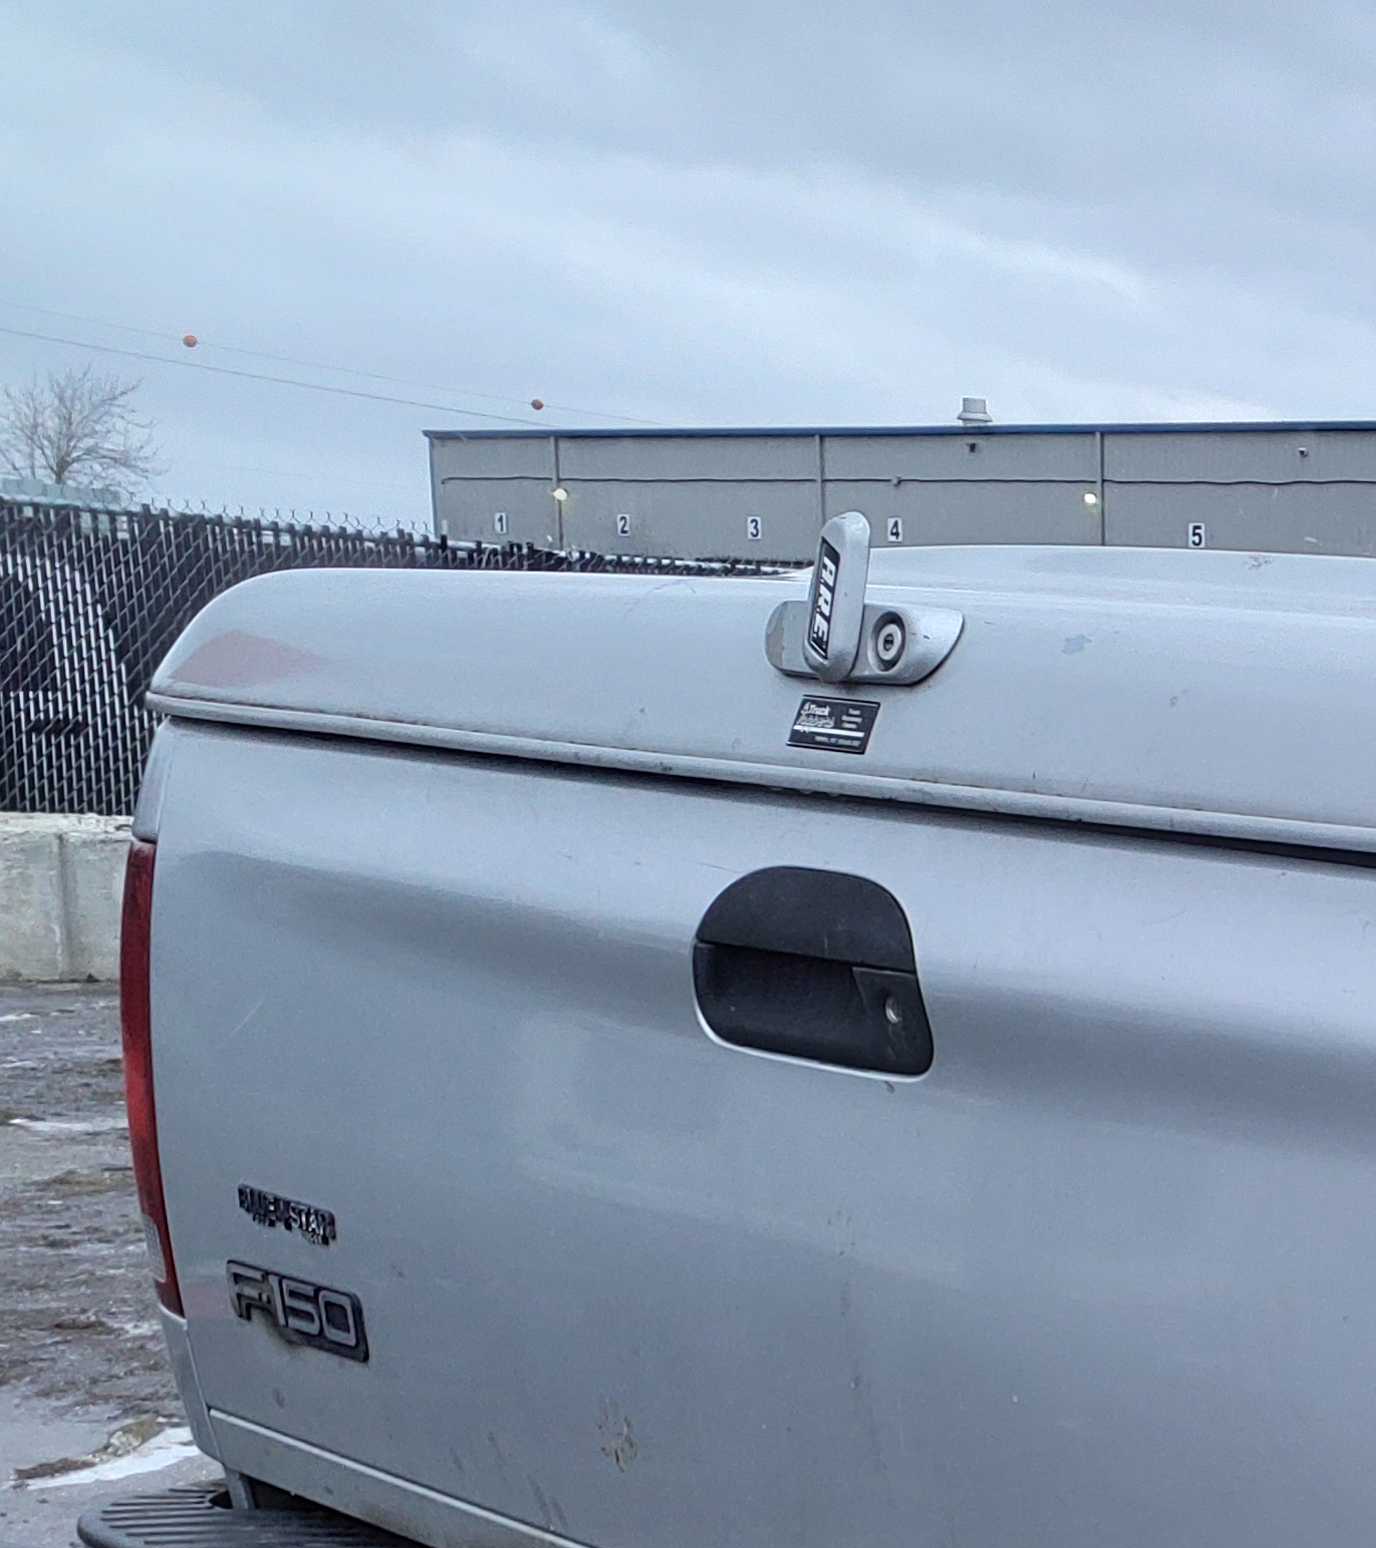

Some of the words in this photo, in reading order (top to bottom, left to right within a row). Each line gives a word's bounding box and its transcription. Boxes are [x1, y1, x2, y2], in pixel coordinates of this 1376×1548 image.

[497, 515, 505, 533] 1
[619, 516, 629, 534] 2
[750, 518, 760, 538] 3
[889, 519, 900, 540] 4
[1191, 525, 1203, 546] 5
